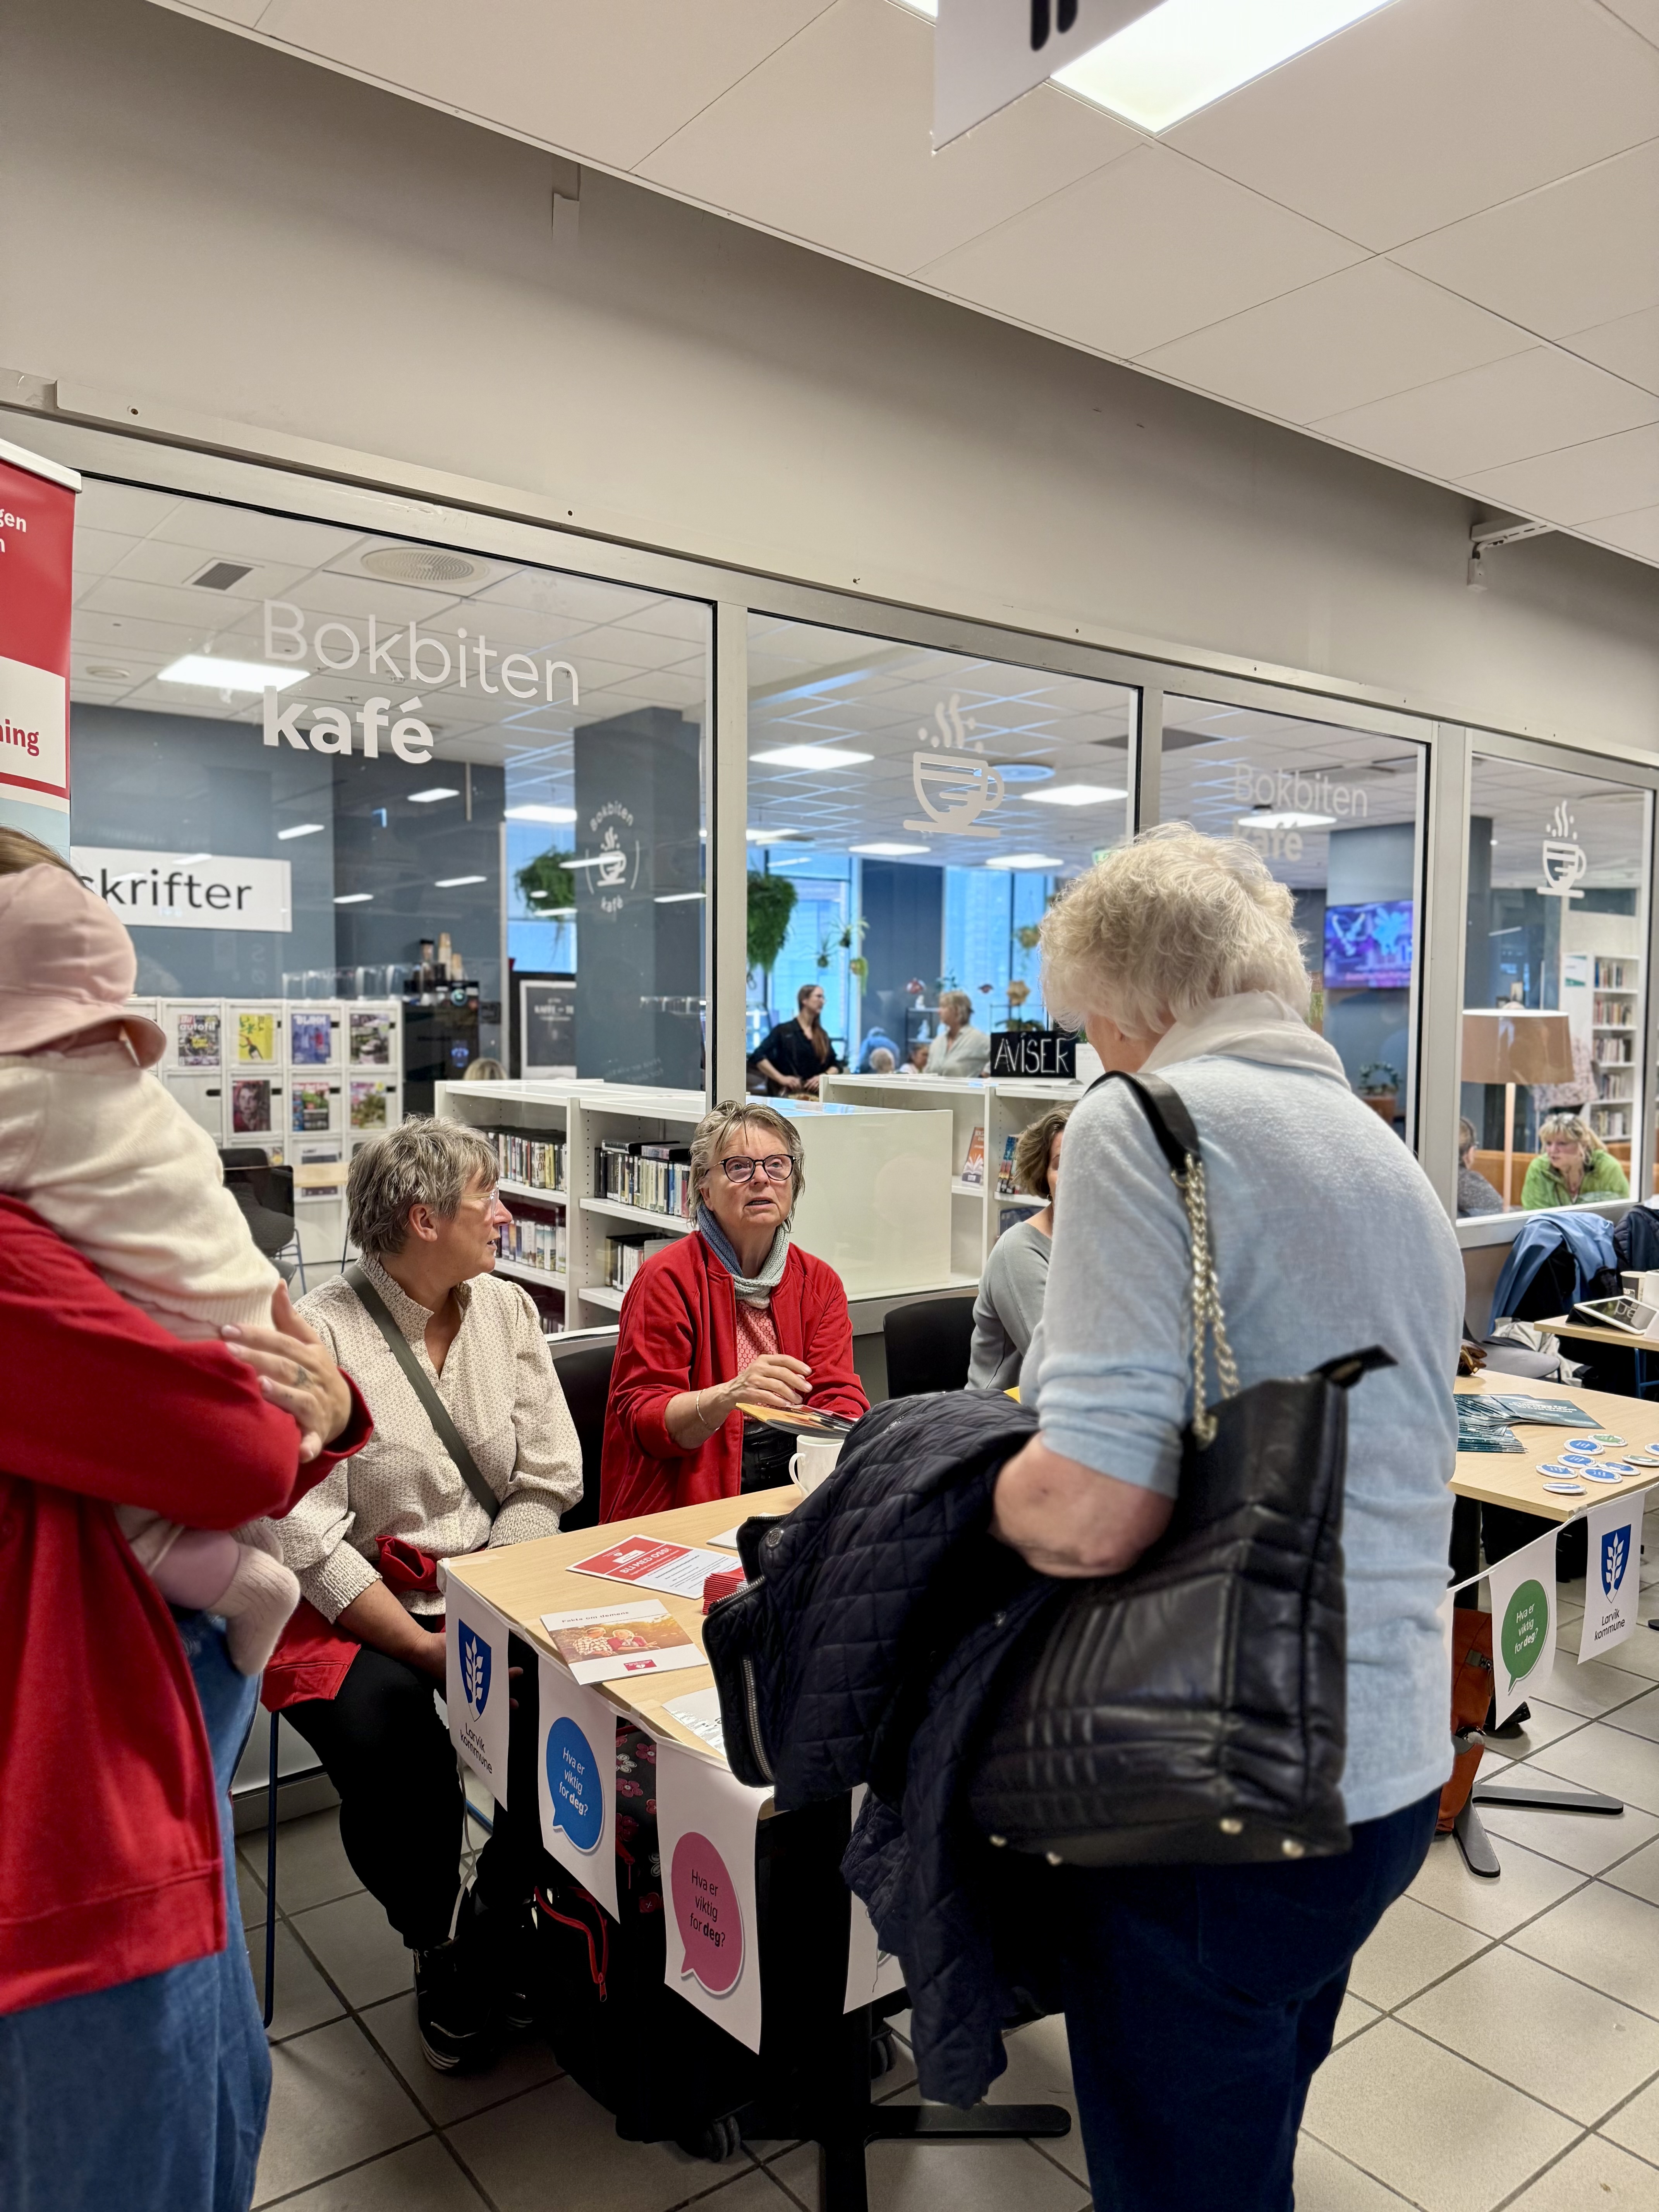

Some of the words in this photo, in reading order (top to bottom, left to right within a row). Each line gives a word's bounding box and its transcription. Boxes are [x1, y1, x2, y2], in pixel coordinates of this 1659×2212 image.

[264, 599, 579, 705] Bokbiten
[0, 719, 40, 756] ing
[263, 686, 434, 764] kafé
[1235, 763, 1368, 817] Bokbiten
[590, 800, 634, 832] Bokbiten
[620, 1564, 635, 1573] BLI
[633, 1557, 653, 1567] MED
[650, 1547, 672, 1558] OSS!
[1516, 1609, 1528, 1623] Hva
[1528, 1603, 1535, 1614] er
[1602, 1608, 1620, 1626] Larvik
[1515, 1641, 1523, 1654] for
[1523, 1628, 1538, 1647] deg?
[1518, 1619, 1534, 1636] viktig
[1594, 1619, 1625, 1641] kommune
[460, 1729, 492, 1774] kommune
[465, 1722, 485, 1753] Larvik
[563, 1747, 576, 1769] Hva
[577, 1763, 585, 1775] er
[564, 1769, 583, 1795] viktig
[559, 1781, 569, 1799] for
[569, 1793, 588, 1816] deg?
[692, 1869, 708, 1891] Hva
[709, 1883, 718, 1896] er
[695, 1896, 718, 1923] viktig
[690, 1912, 702, 1932] for
[703, 1922, 726, 1947] deg?
